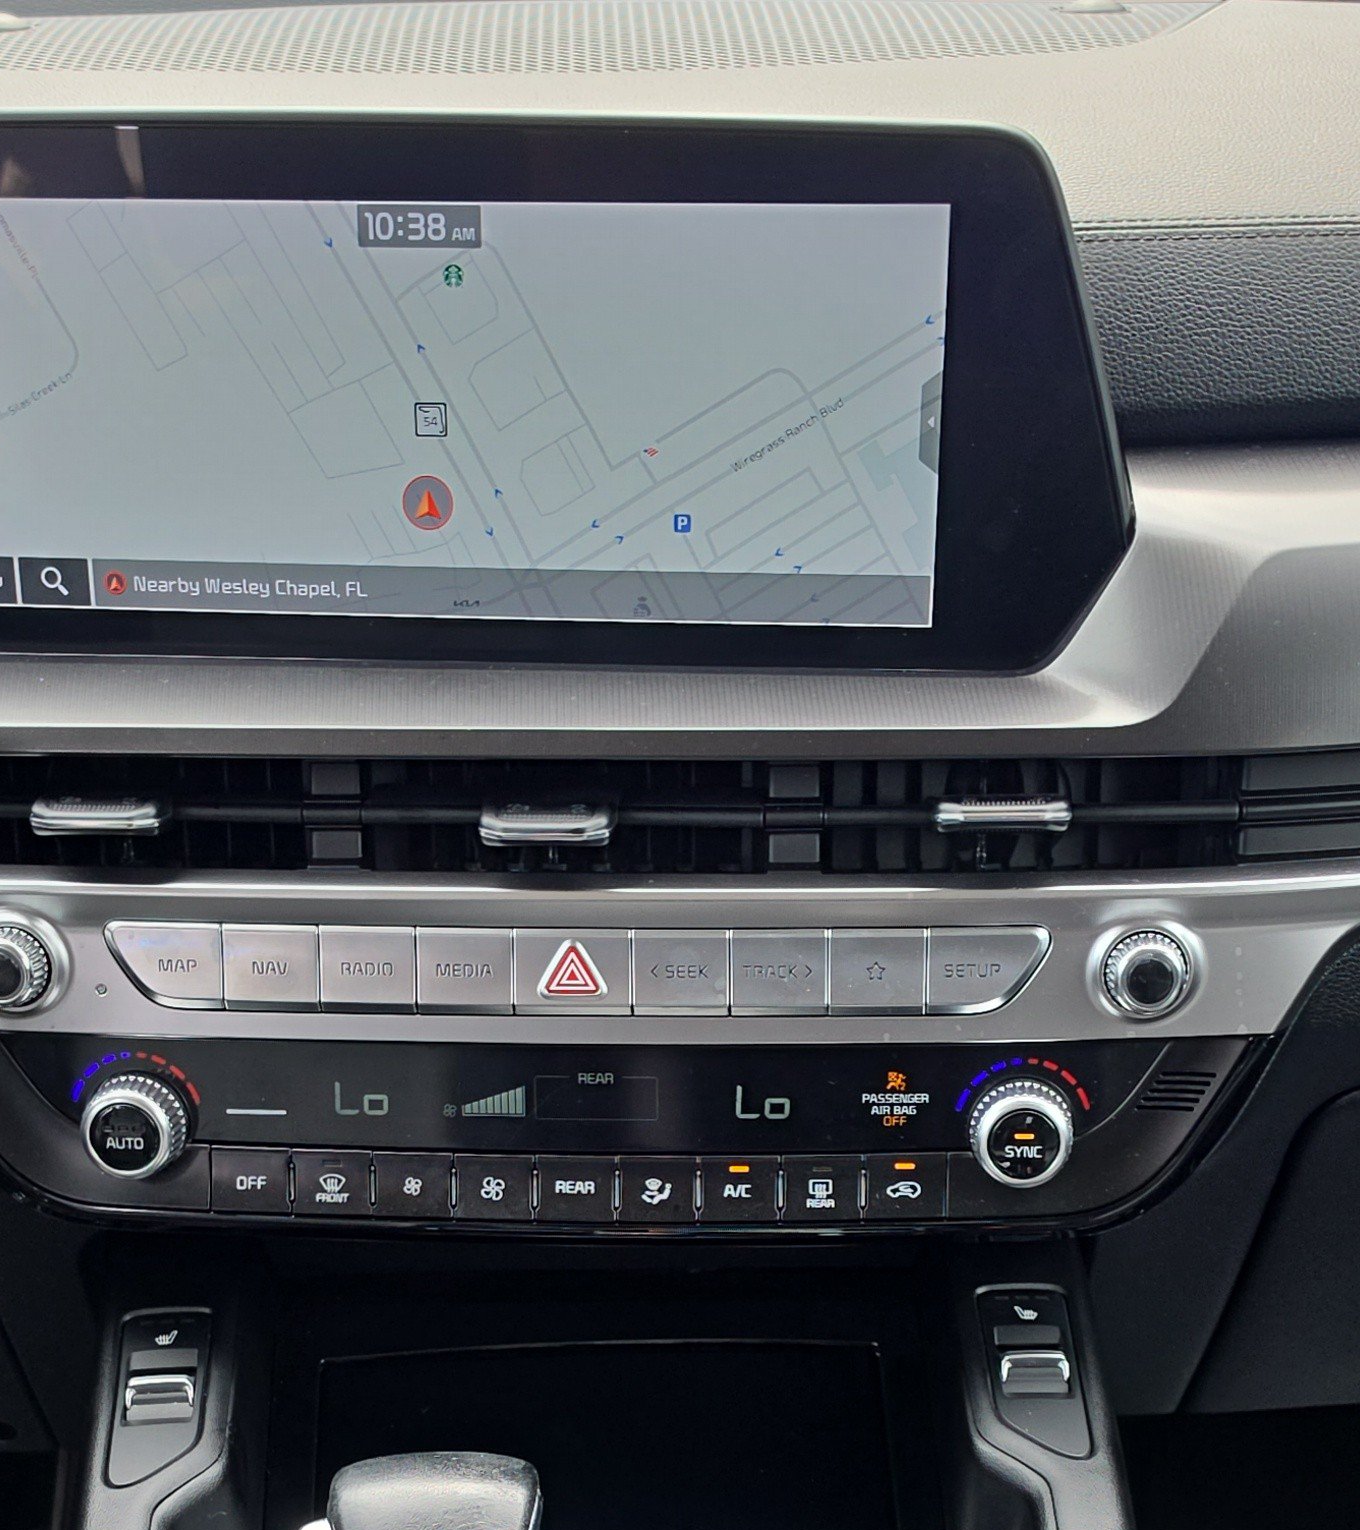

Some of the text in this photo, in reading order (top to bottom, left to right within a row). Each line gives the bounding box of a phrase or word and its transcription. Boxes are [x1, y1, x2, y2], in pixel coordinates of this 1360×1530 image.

[364, 212, 476, 241] 10:38 AM
[730, 397, 844, 472] Wiregrass Ranch Blvd
[133, 576, 368, 599] Nearby Wesley Chapel, FL
[157, 958, 197, 972] MAP
[252, 960, 288, 975] NAV
[340, 961, 394, 976] RADIO
[435, 963, 492, 978] MEDIA
[665, 964, 709, 979] SEEK
[742, 964, 797, 979] TRACK
[944, 963, 1001, 978] SETUP
[577, 1073, 614, 1085] REAR
[334, 1081, 389, 1116] Lo
[735, 1085, 790, 1119] Lo
[862, 1093, 930, 1104] PASSENGER
[871, 1105, 917, 1115] AIR BAG
[883, 1116, 907, 1127] OFF
[106, 1137, 144, 1150] AUTO
[1004, 1145, 1043, 1159] SYNC
[236, 1175, 267, 1190] OFF
[555, 1180, 595, 1195] REAR
[316, 1192, 350, 1203] FRONT
[724, 1184, 752, 1198] A/C
[806, 1198, 835, 1208] REAR
